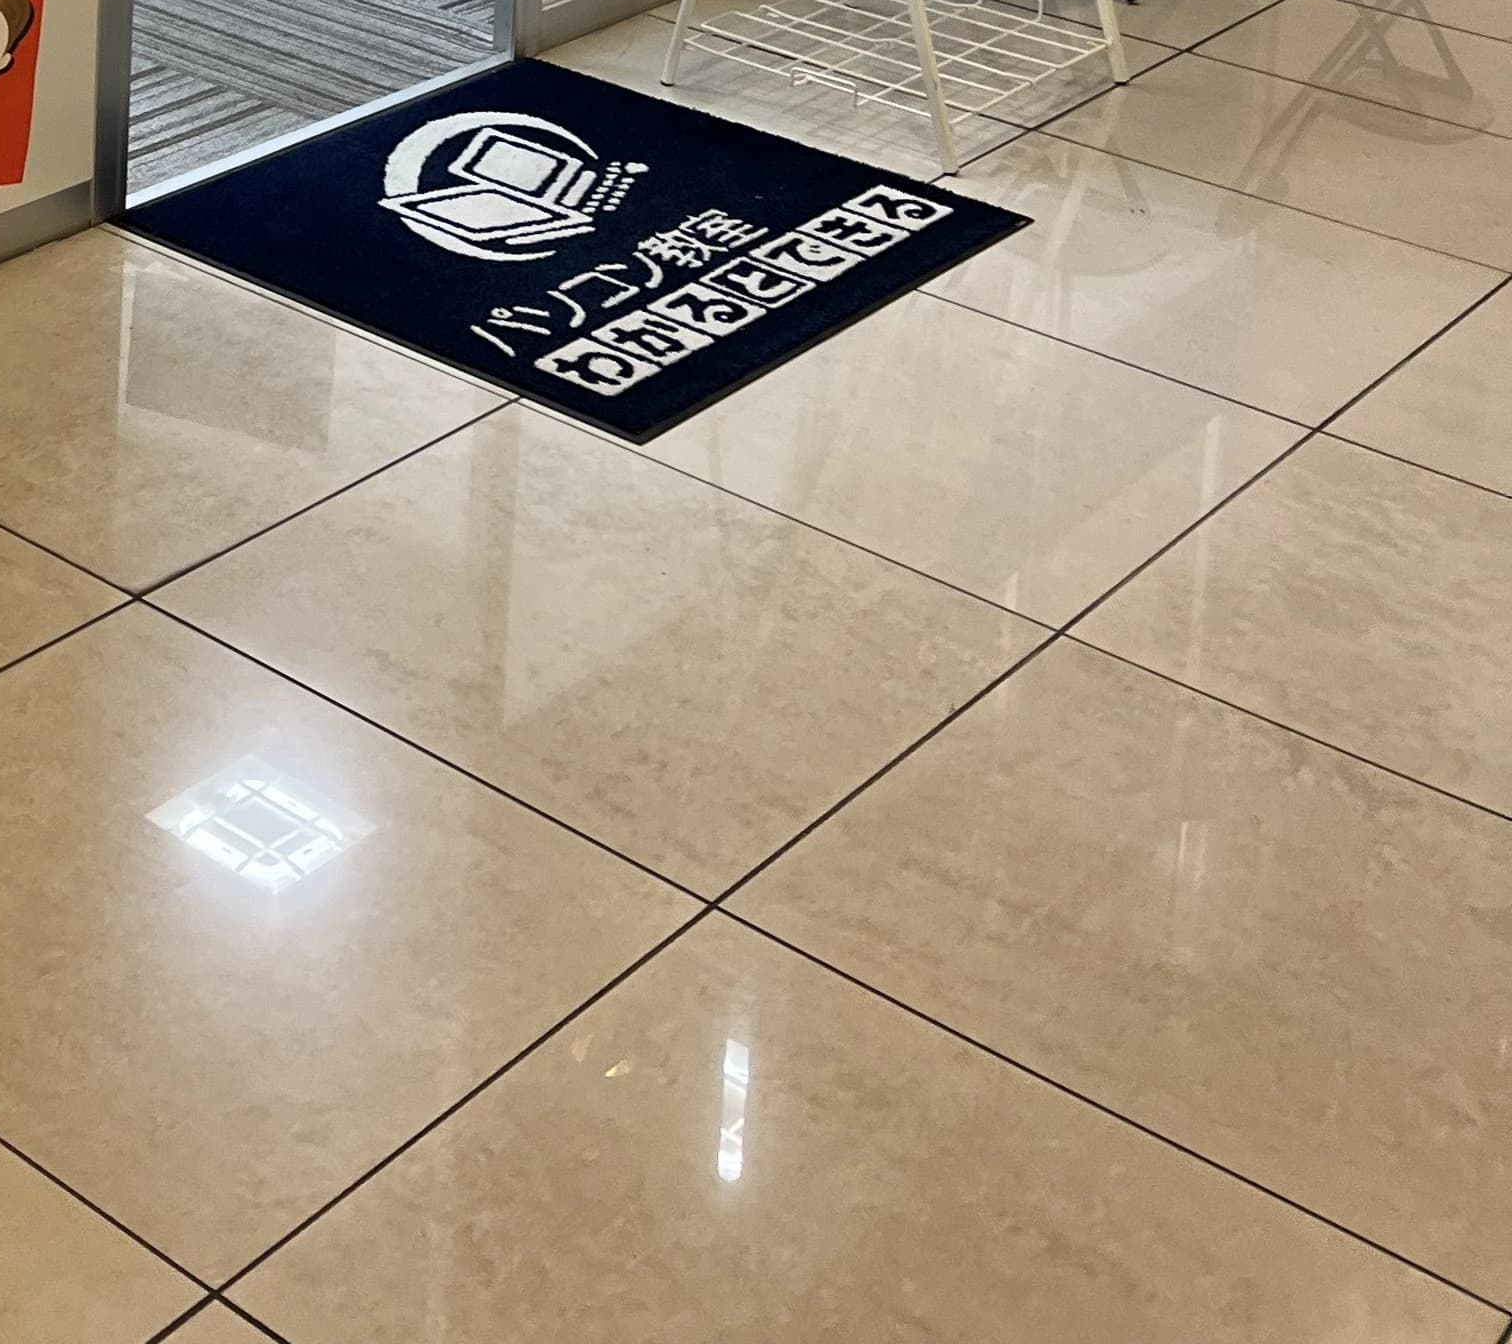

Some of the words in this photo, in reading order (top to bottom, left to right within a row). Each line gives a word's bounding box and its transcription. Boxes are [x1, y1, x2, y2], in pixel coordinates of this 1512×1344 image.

[470, 208, 769, 357] パソコン教室
[534, 184, 954, 396] わかるとできる
